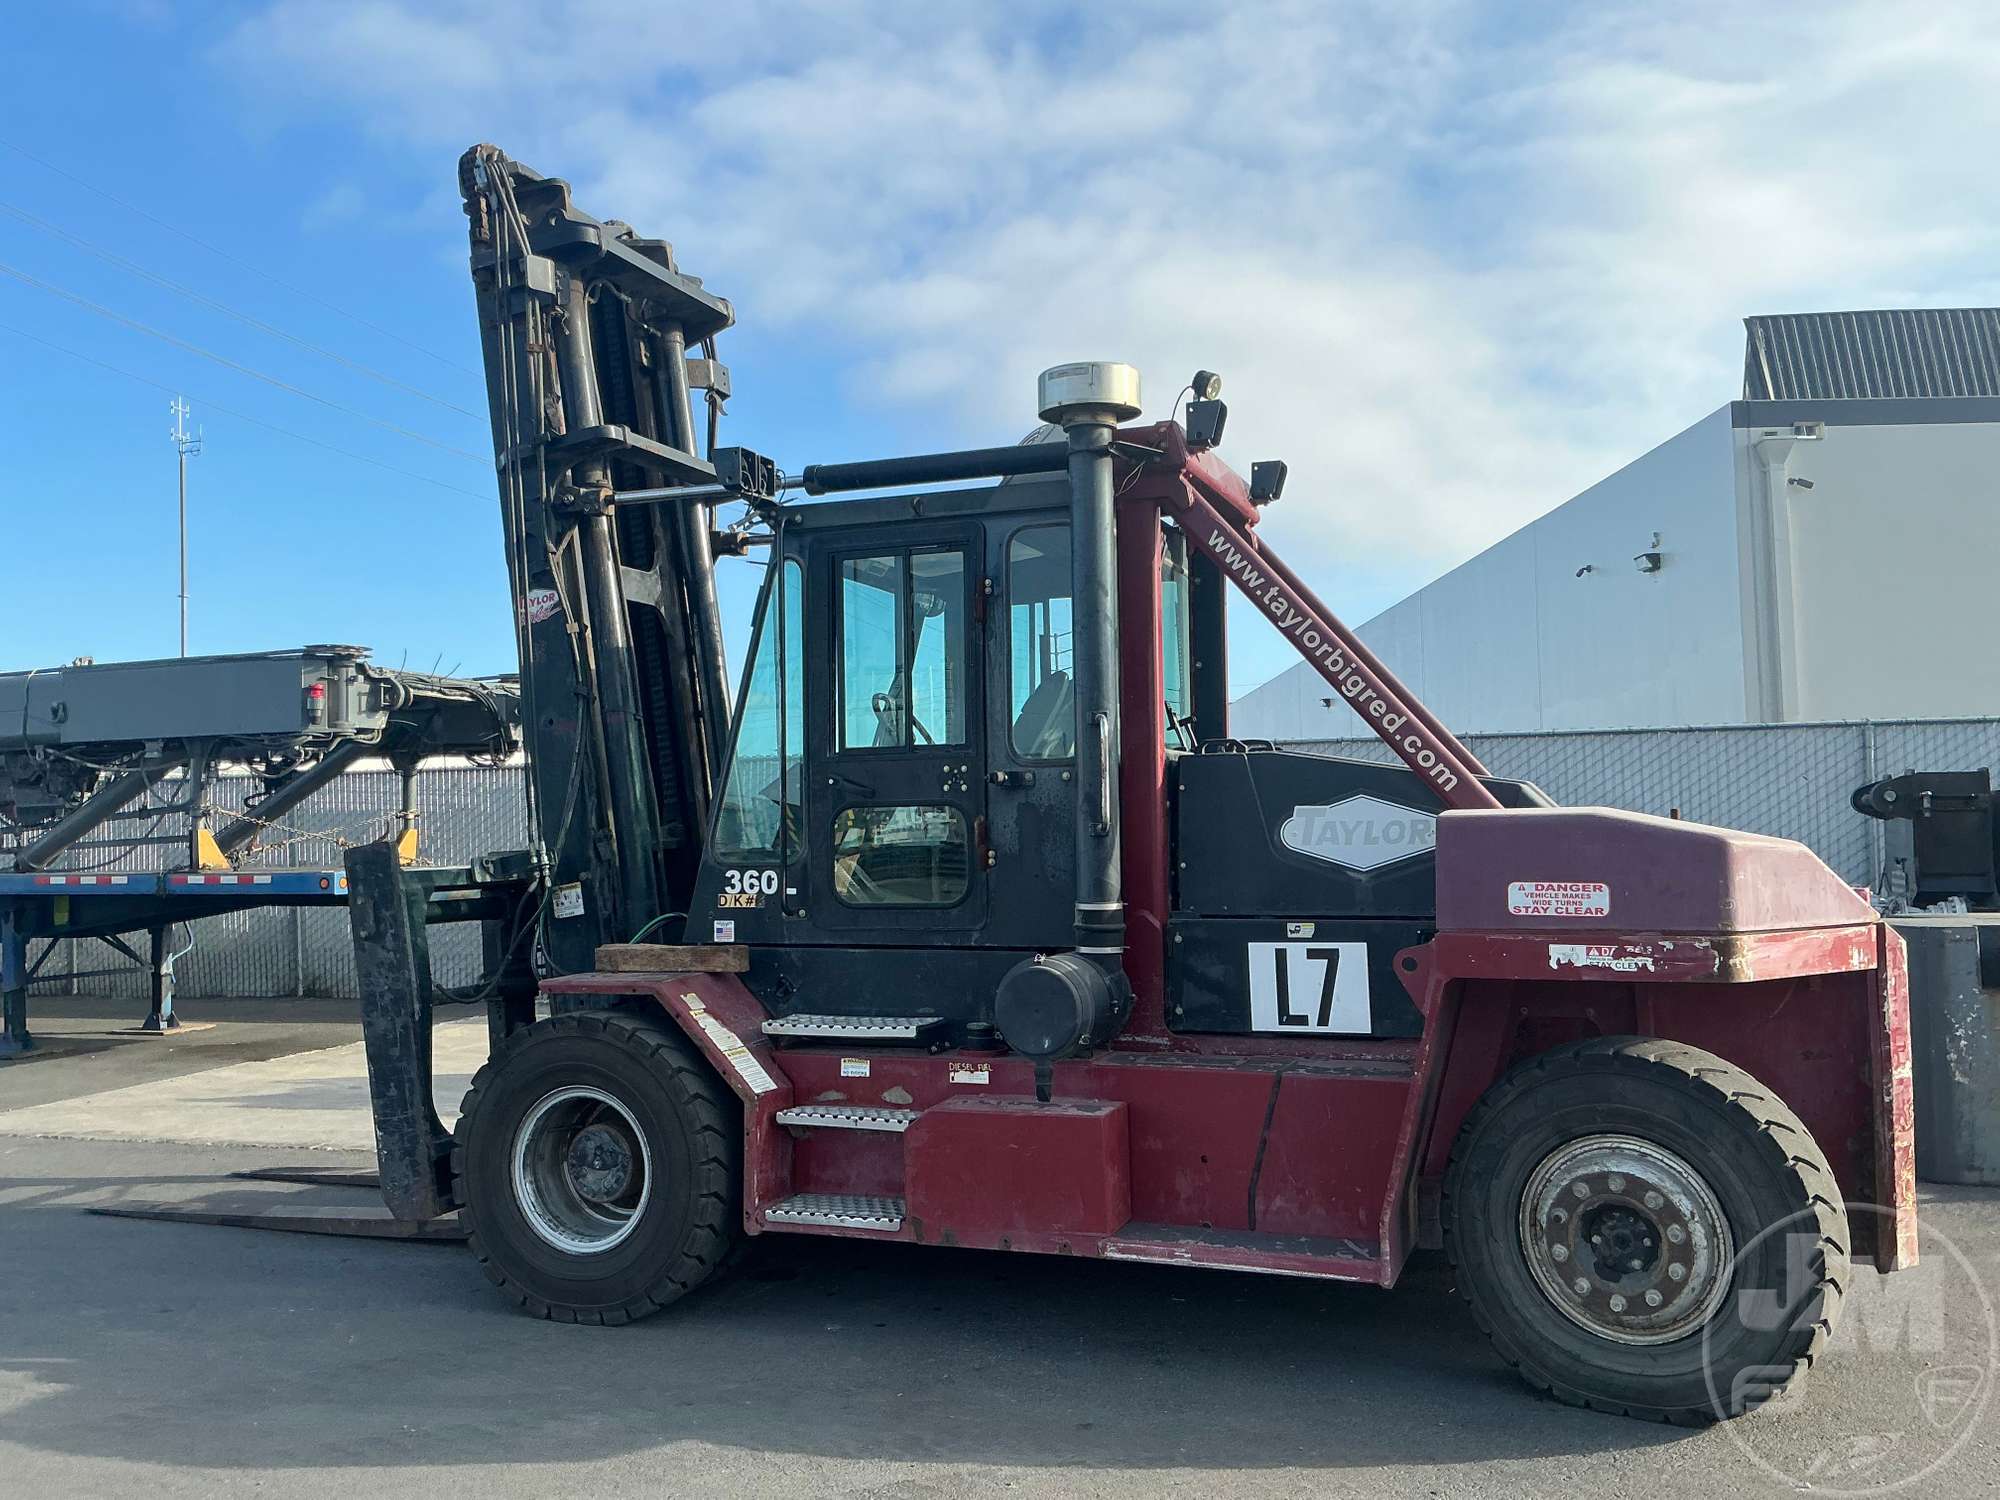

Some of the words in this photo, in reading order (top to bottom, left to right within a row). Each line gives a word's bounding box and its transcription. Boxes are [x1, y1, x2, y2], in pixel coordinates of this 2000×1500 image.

[1207, 529, 1458, 792] www.taylorbigred.com
[1293, 806, 1431, 846] TAYLOR
[1535, 884, 1604, 892] DANGER
[1513, 905, 1550, 914] STAY
[1555, 906, 1605, 915] CLEAR
[1275, 948, 1340, 1026] L7
[949, 1062, 974, 1071] DIESEL
